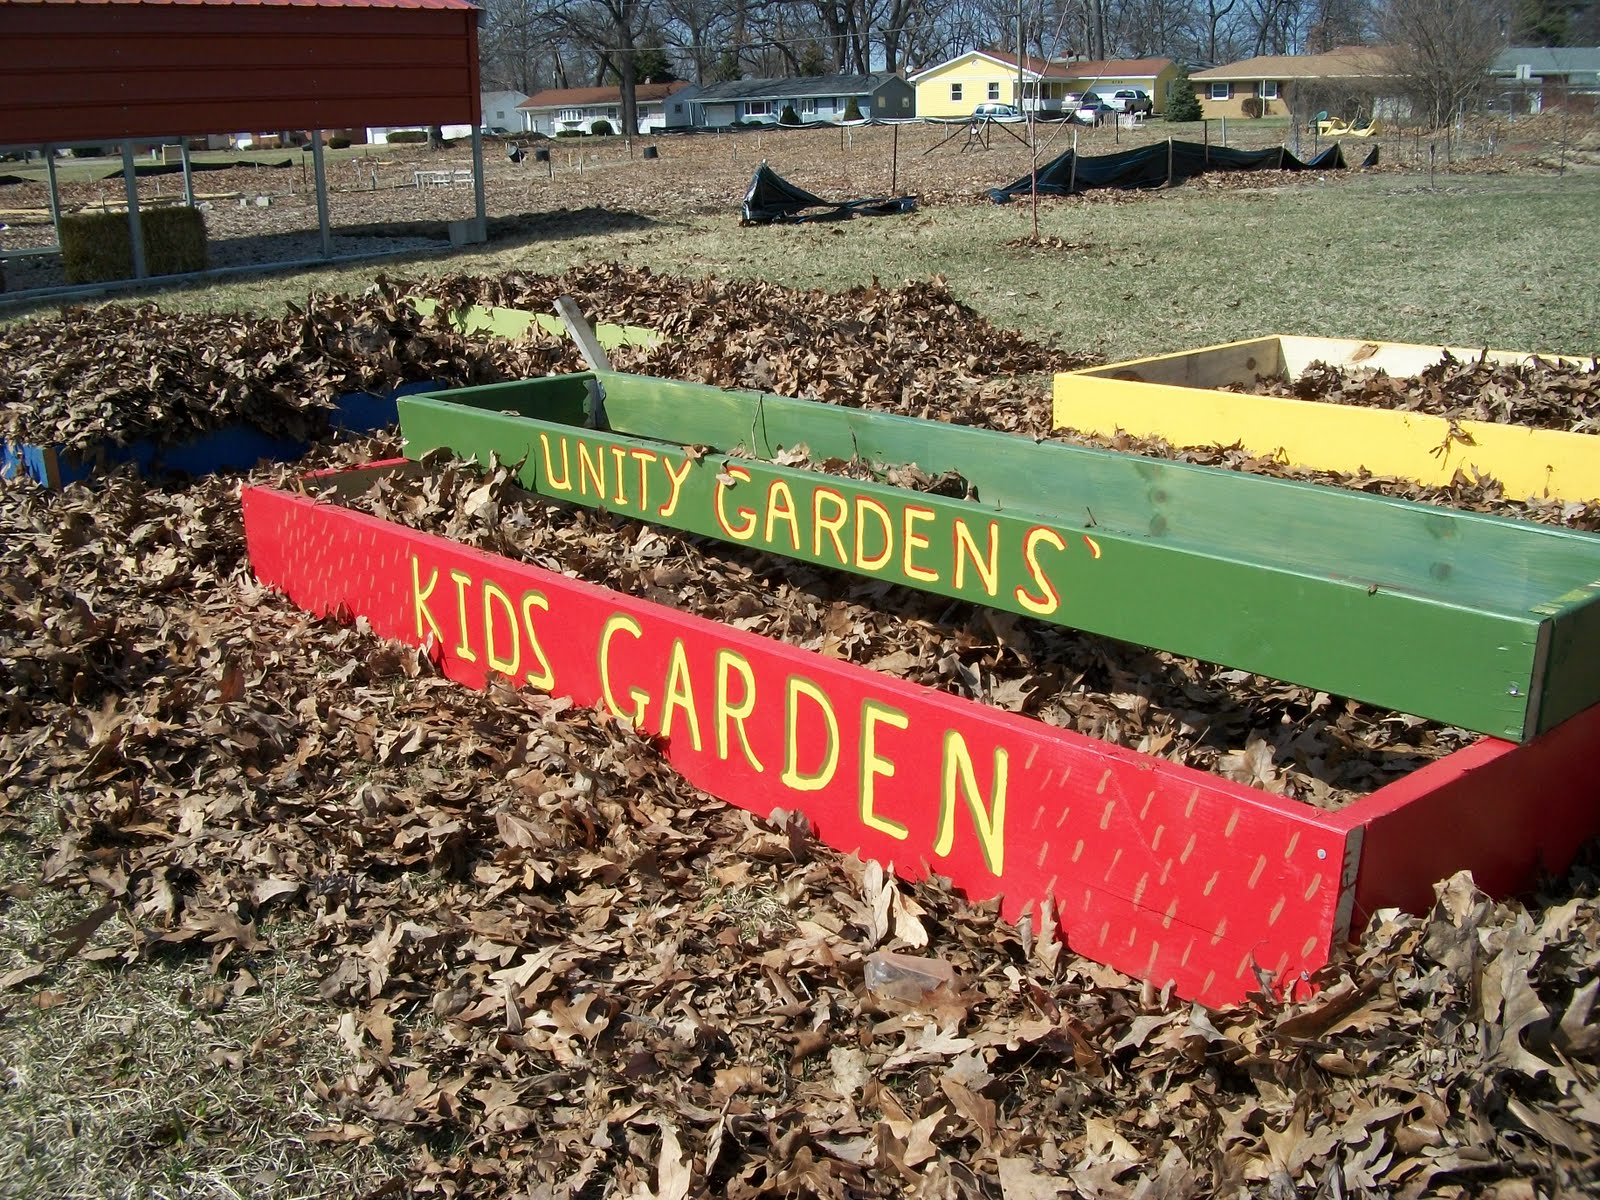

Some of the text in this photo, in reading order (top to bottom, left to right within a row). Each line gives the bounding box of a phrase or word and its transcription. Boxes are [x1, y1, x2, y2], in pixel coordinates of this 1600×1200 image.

[538, 432, 692, 518] UNITY
[411, 554, 1009, 877] KIDS GARDEN
